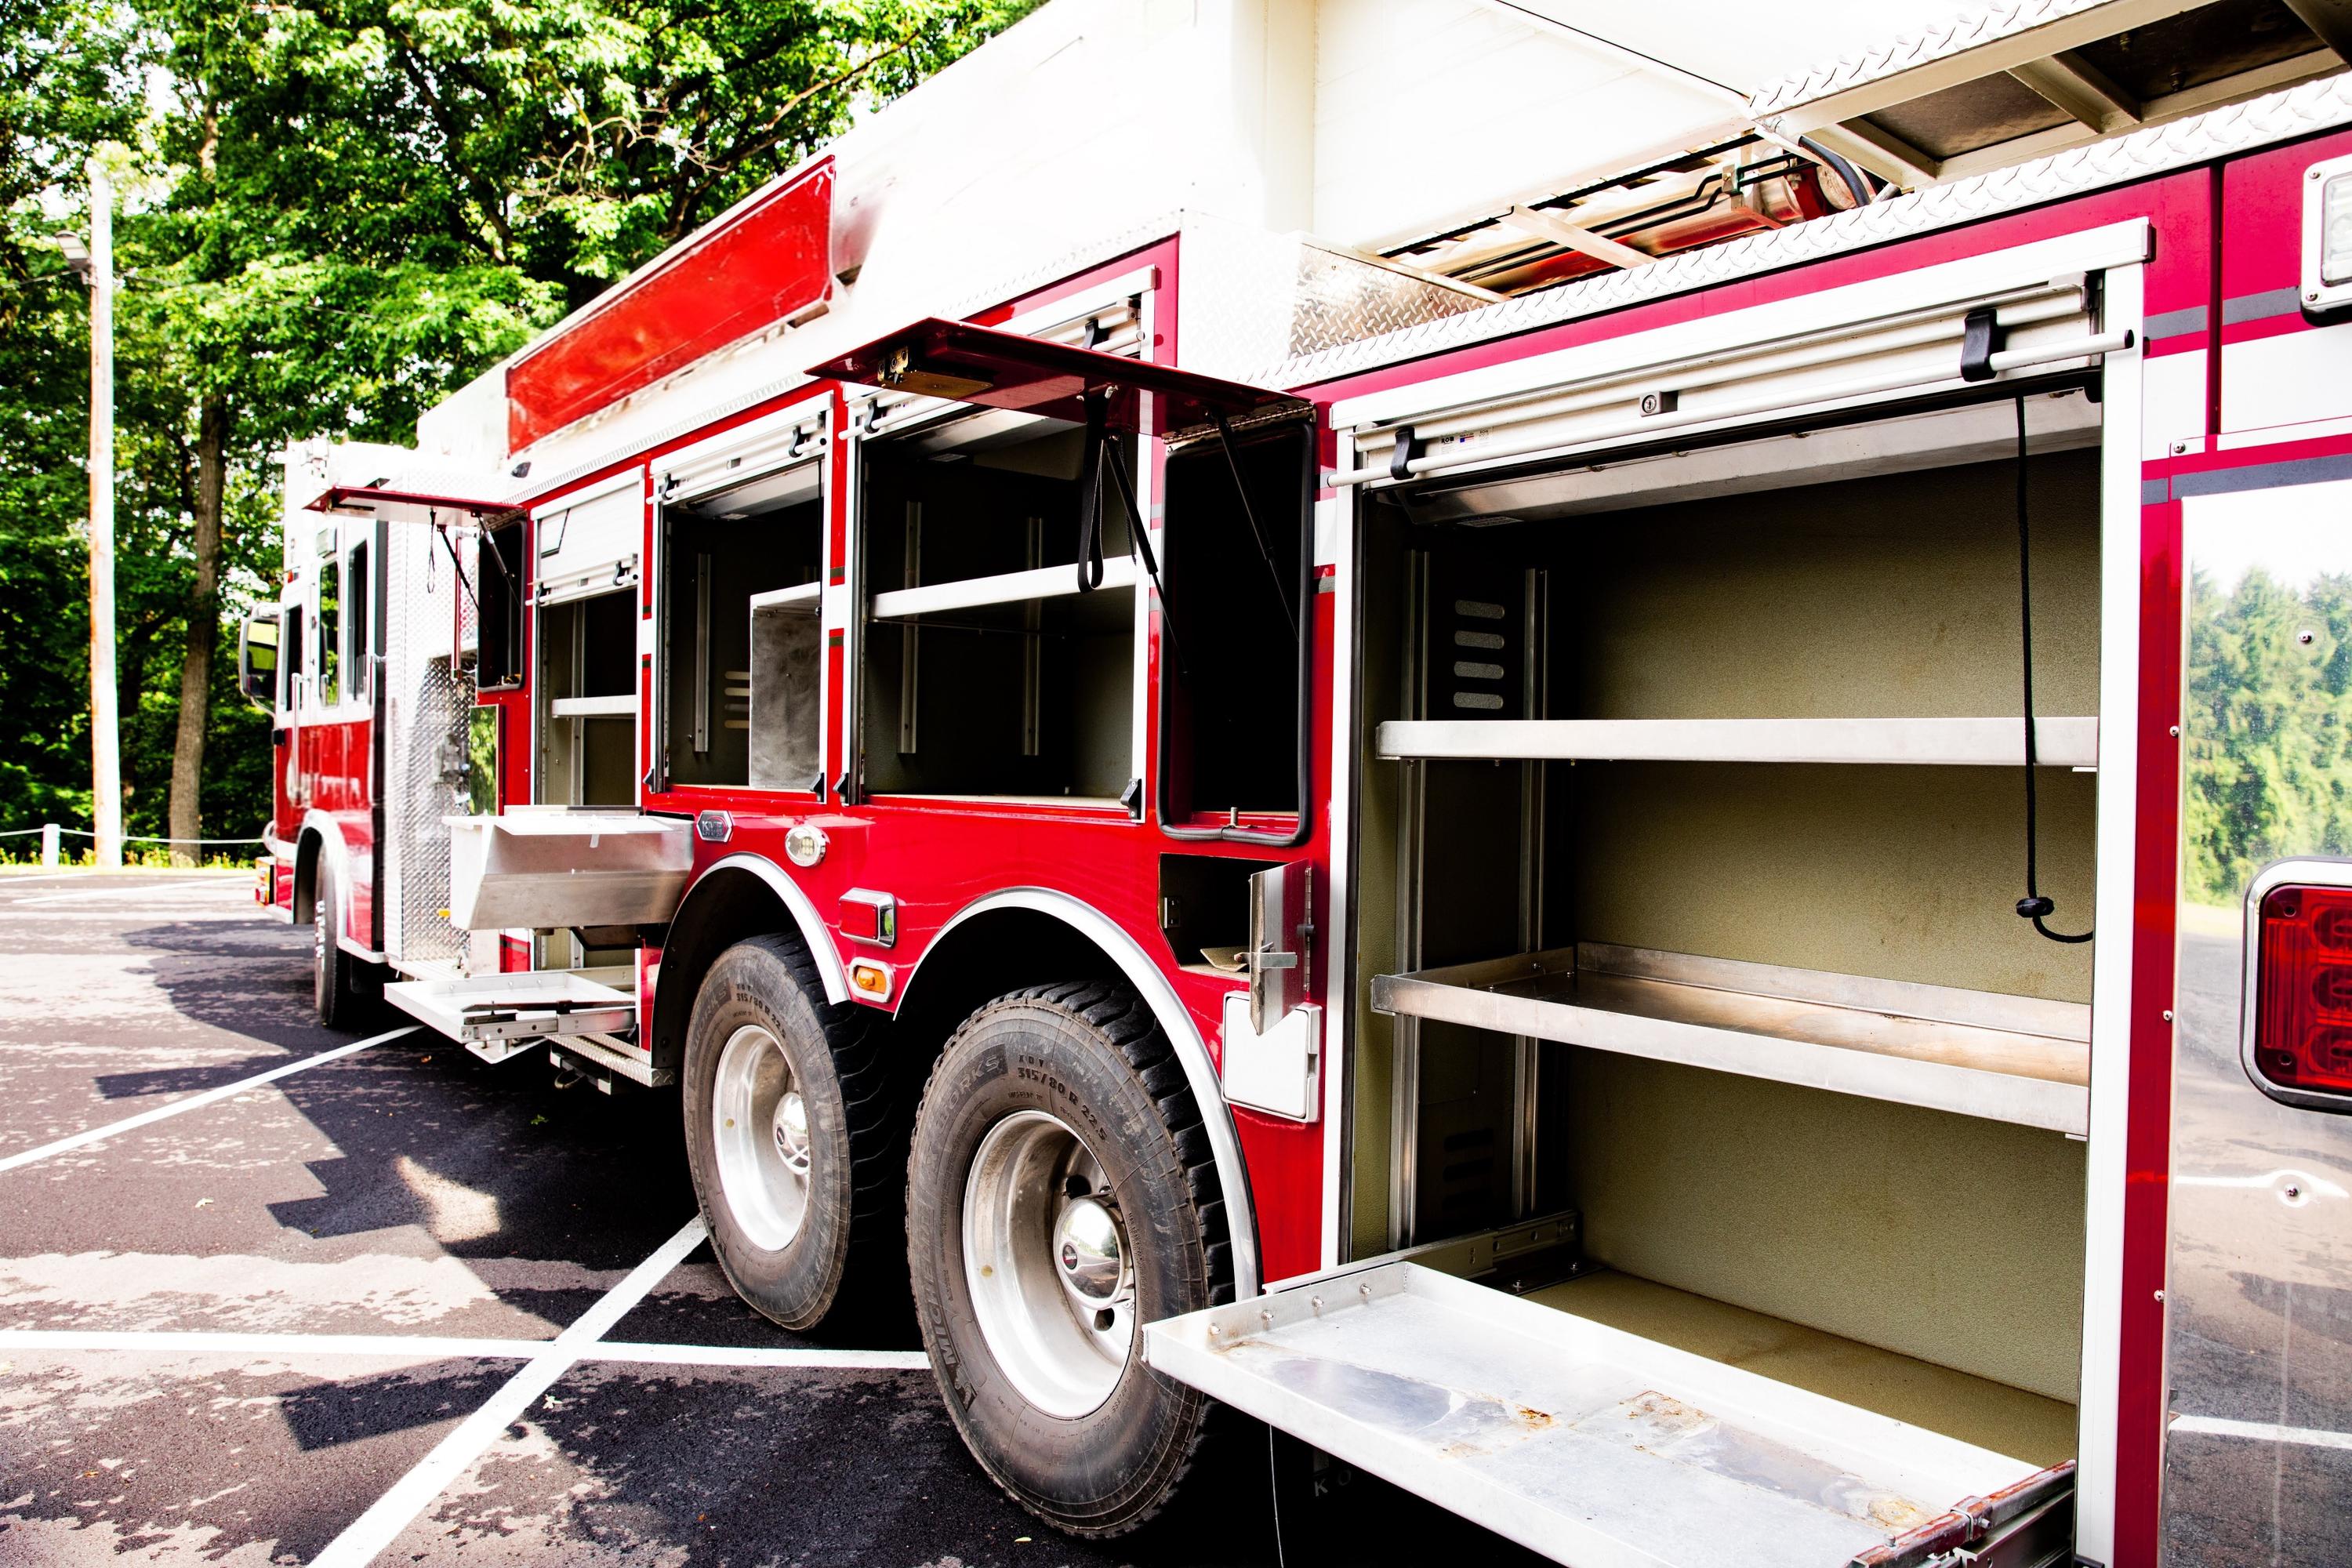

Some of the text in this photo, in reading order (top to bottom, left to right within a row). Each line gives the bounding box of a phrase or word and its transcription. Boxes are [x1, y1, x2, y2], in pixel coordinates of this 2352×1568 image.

[1018, 1067, 1065, 1095] 315/80
[1069, 1091, 1079, 1105] R
[1080, 1105, 1108, 1141] 22.5
